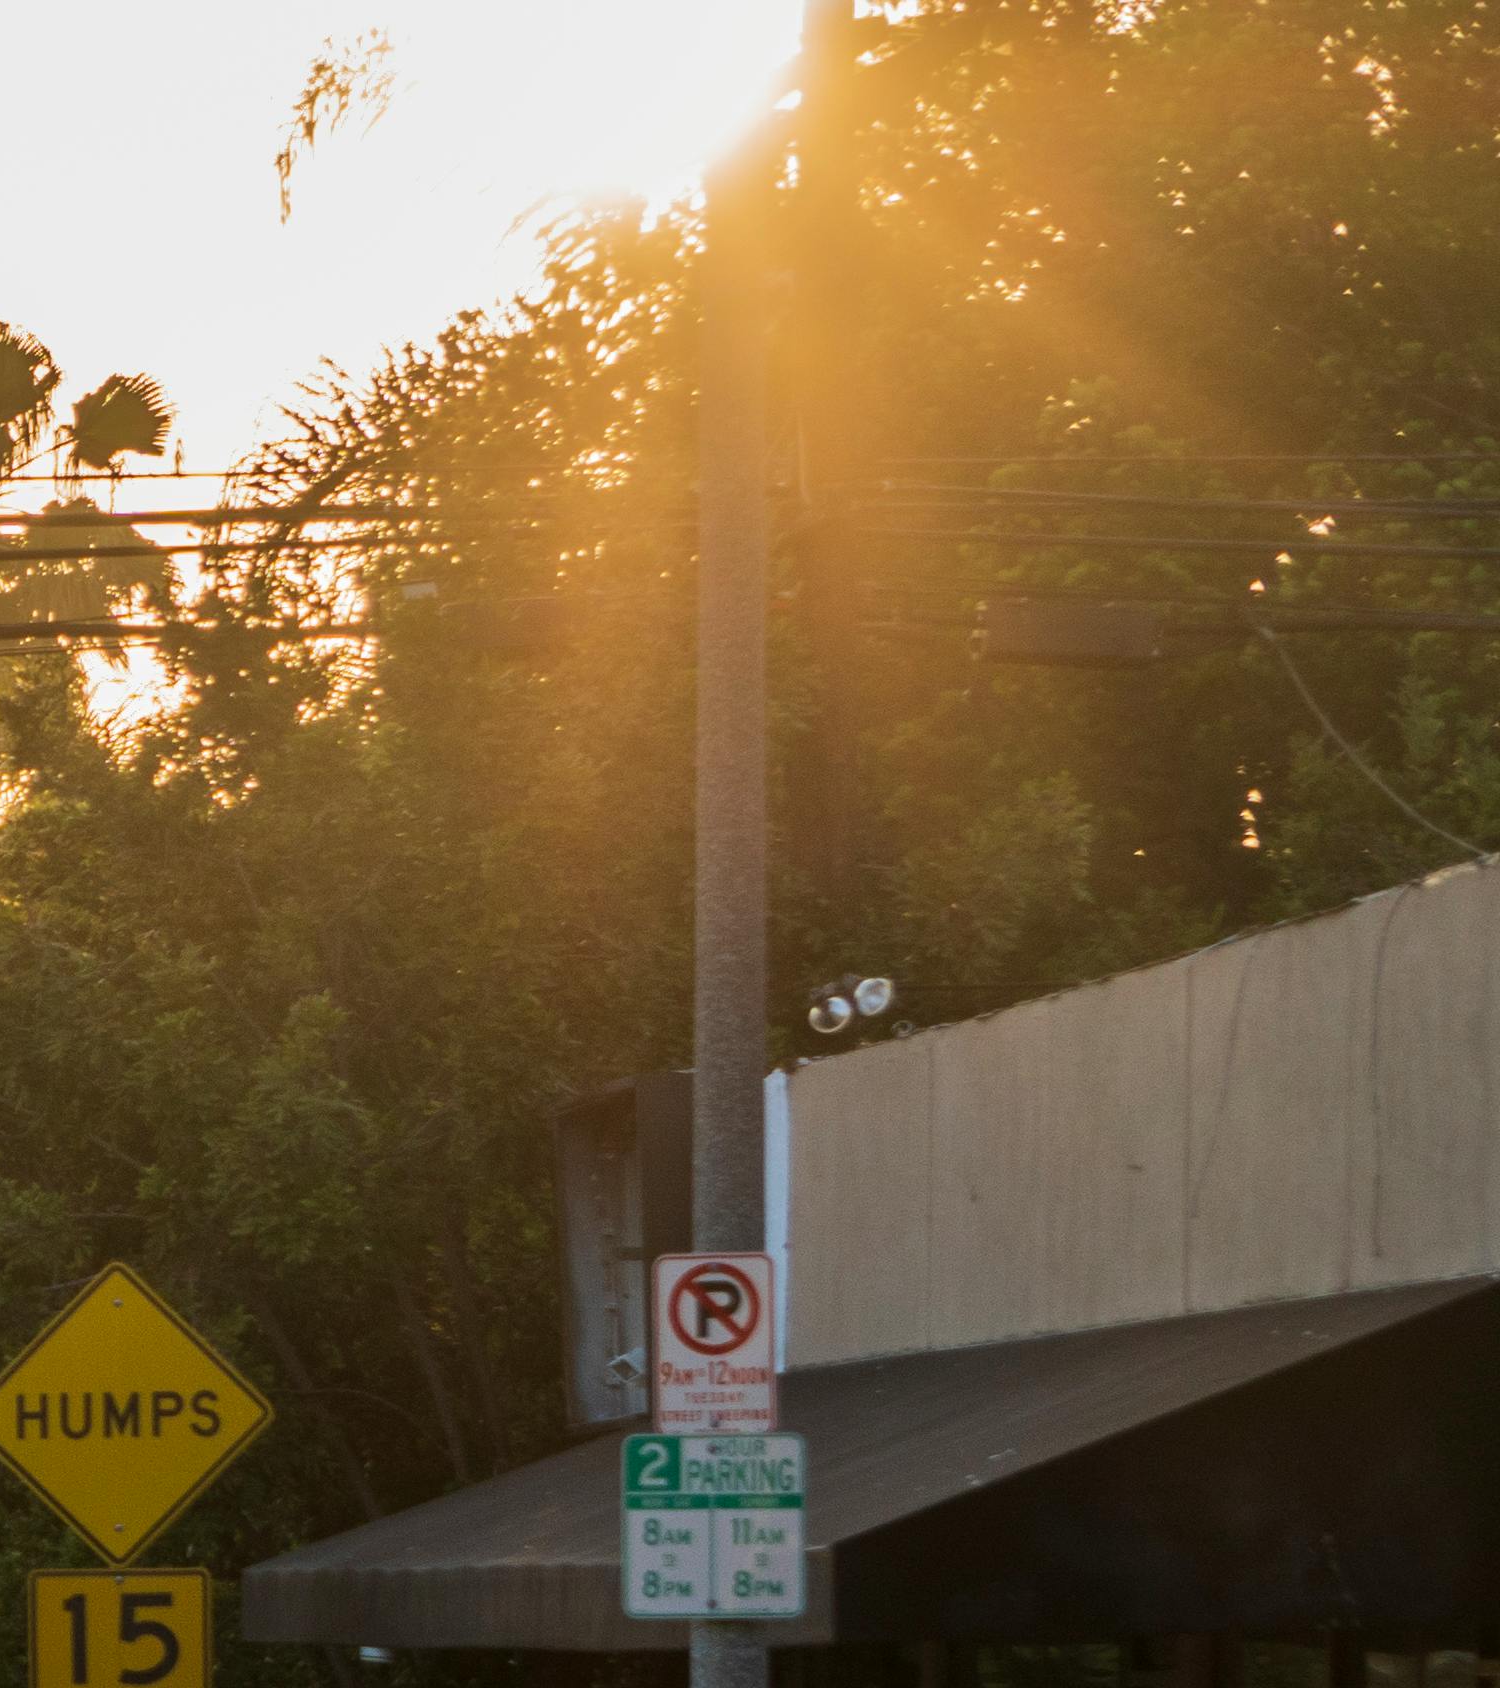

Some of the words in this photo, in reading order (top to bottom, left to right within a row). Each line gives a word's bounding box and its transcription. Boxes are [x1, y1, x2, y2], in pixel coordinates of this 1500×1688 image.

[15, 1389, 221, 1440] HUMPS
[637, 1442, 670, 1487] 2
[686, 1458, 794, 1491] PARKING
[642, 1517, 692, 1546] 8AM
[732, 1517, 785, 1545] 11AM
[642, 1570, 693, 1598] 8PM
[733, 1570, 785, 1597] 8PM
[62, 1592, 181, 1687] 15
